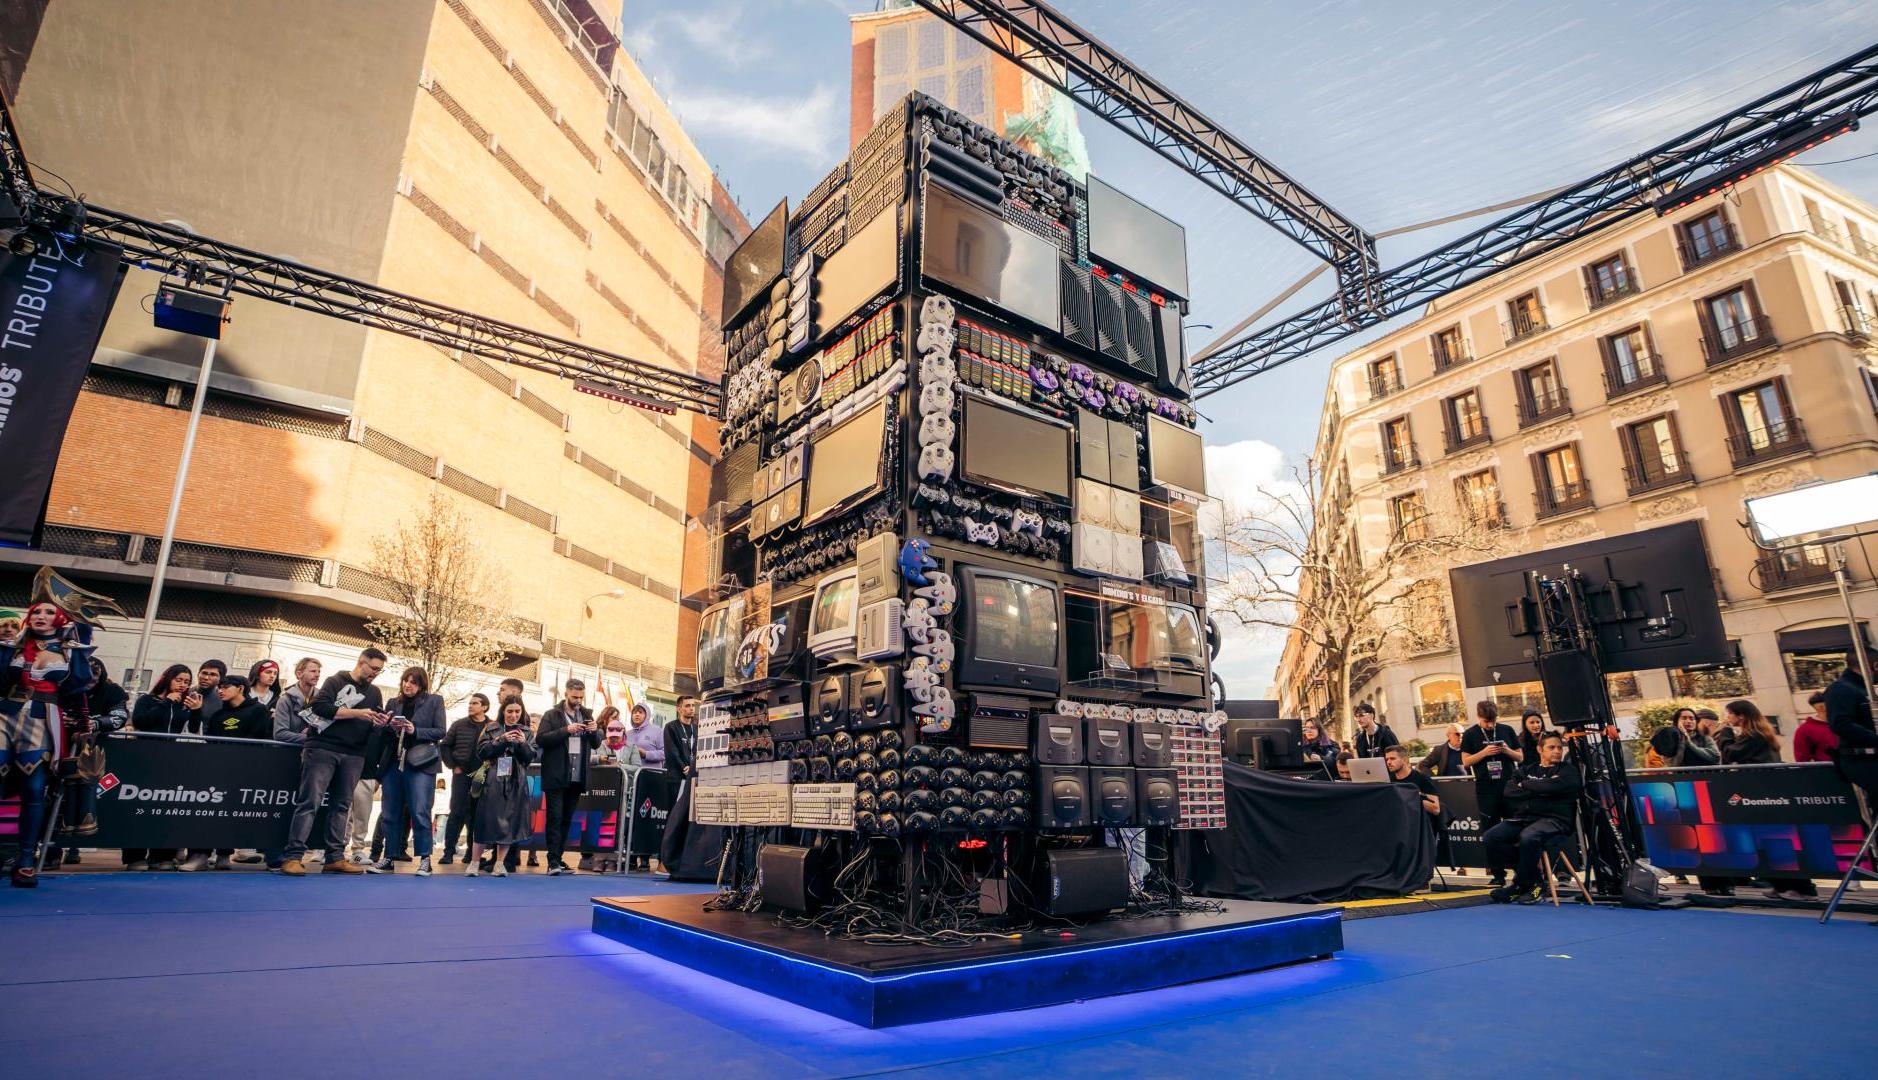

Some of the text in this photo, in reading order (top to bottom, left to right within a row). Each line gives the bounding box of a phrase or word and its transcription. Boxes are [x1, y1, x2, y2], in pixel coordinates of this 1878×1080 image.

[1, 242, 62, 349] TRIBUTE
[118, 784, 330, 807] Domino's TRIBUE
[1742, 796, 1846, 806] Domino's TRIBUTE
[165, 808, 192, 816] AÑOS
[232, 810, 268, 818] GAMING
